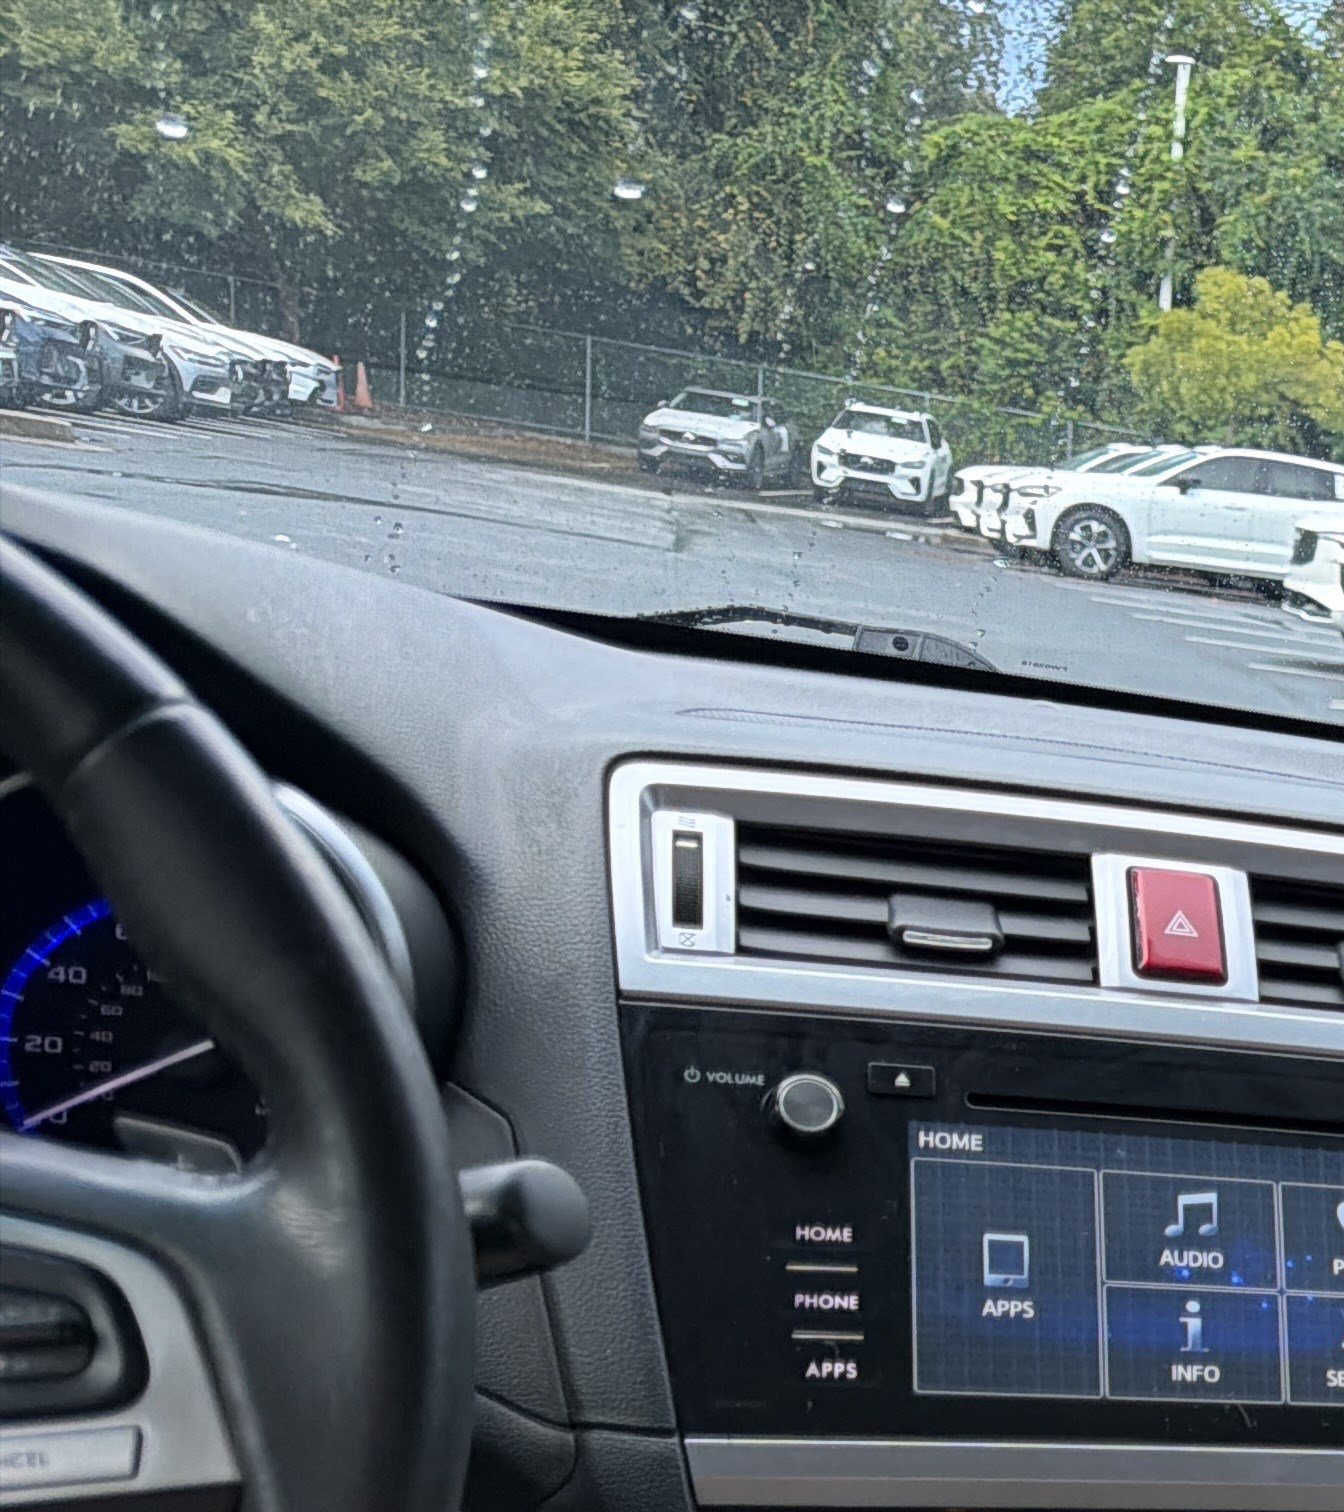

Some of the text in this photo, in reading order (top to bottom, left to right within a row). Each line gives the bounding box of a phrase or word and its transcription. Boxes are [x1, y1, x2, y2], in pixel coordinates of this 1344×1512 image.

[47, 966, 87, 984] 40
[24, 1035, 63, 1054] 20
[89, 1031, 113, 1043] 40
[706, 1071, 765, 1086] VOLUME
[918, 1131, 984, 1152] HOME
[795, 1226, 853, 1243] HOME
[1160, 1249, 1224, 1270] AUDIO
[794, 1293, 859, 1311] PHONE
[982, 1299, 1035, 1319] APPS
[806, 1362, 858, 1380] APPS
[1171, 1364, 1221, 1384] INFO
